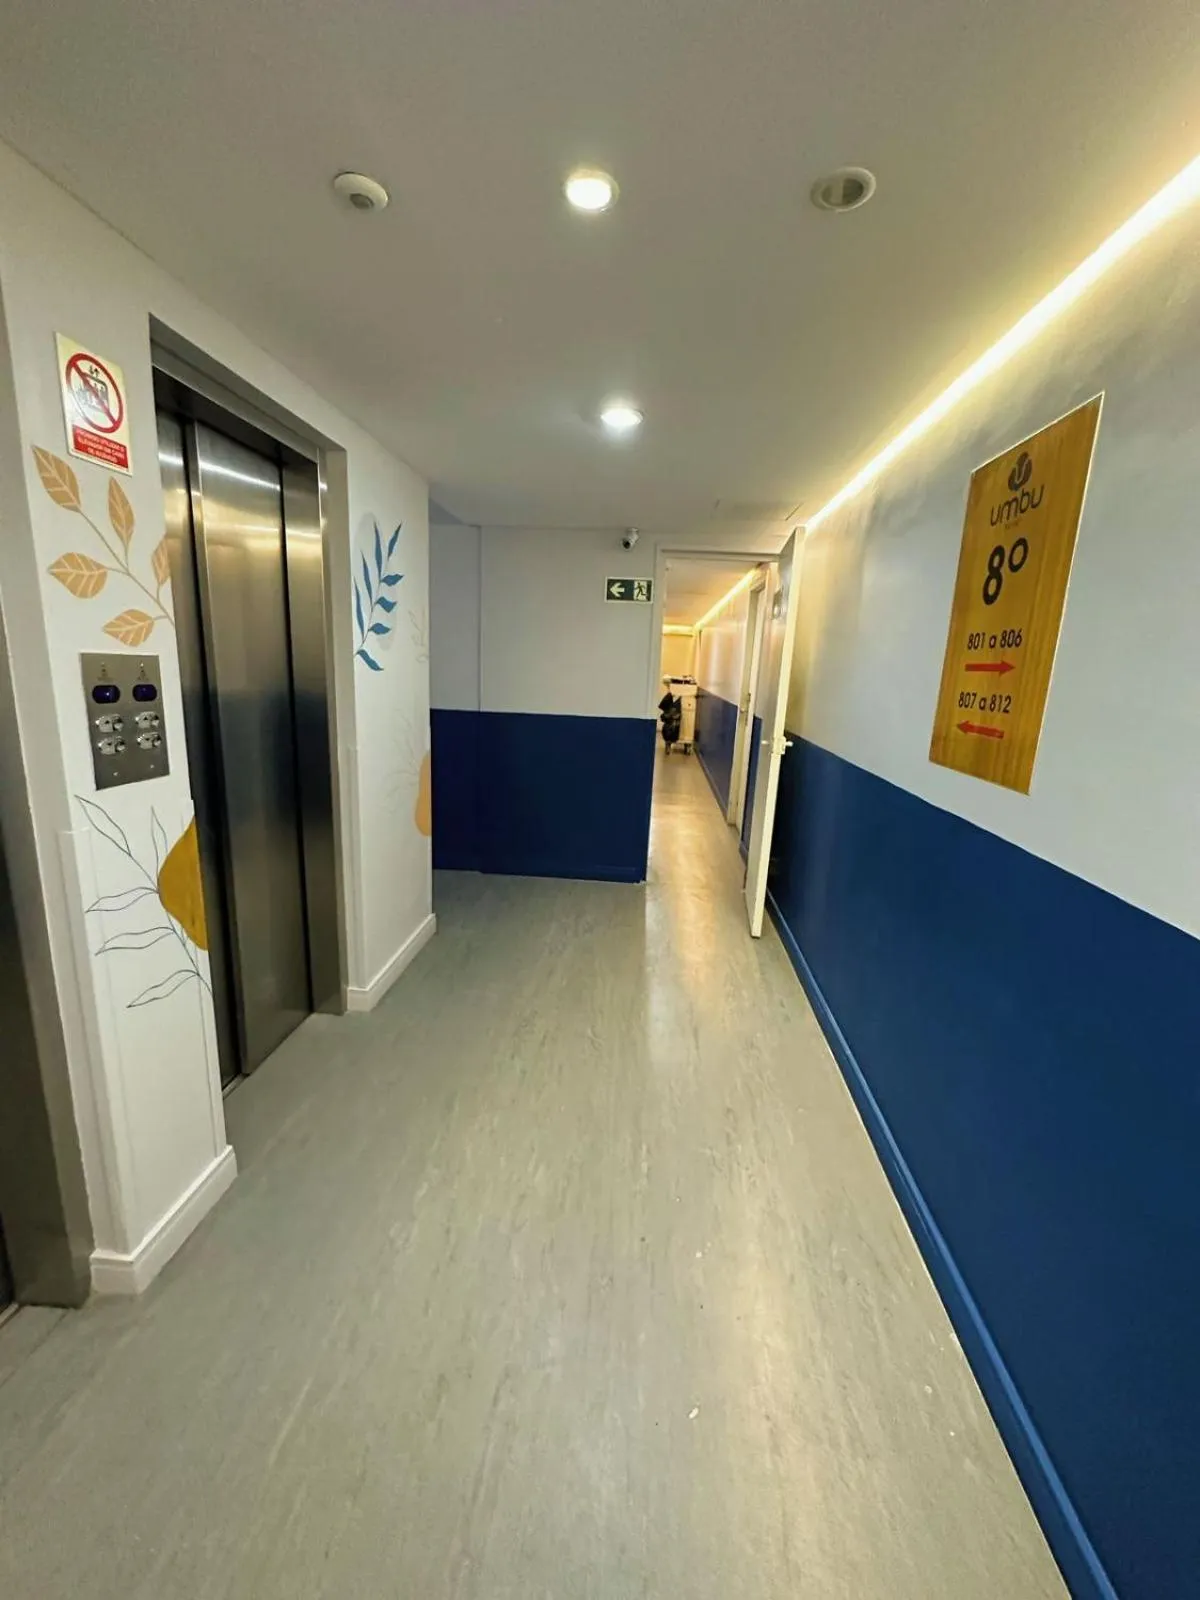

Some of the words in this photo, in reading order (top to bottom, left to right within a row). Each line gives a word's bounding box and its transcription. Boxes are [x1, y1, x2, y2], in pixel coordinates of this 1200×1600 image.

[990, 484, 1045, 526] umbu
[967, 632, 985, 650] 801
[989, 635, 997, 648] a
[1000, 628, 1022, 648] 806
[958, 691, 977, 709] 807
[979, 697, 987, 710] a
[990, 694, 1011, 713] 812
